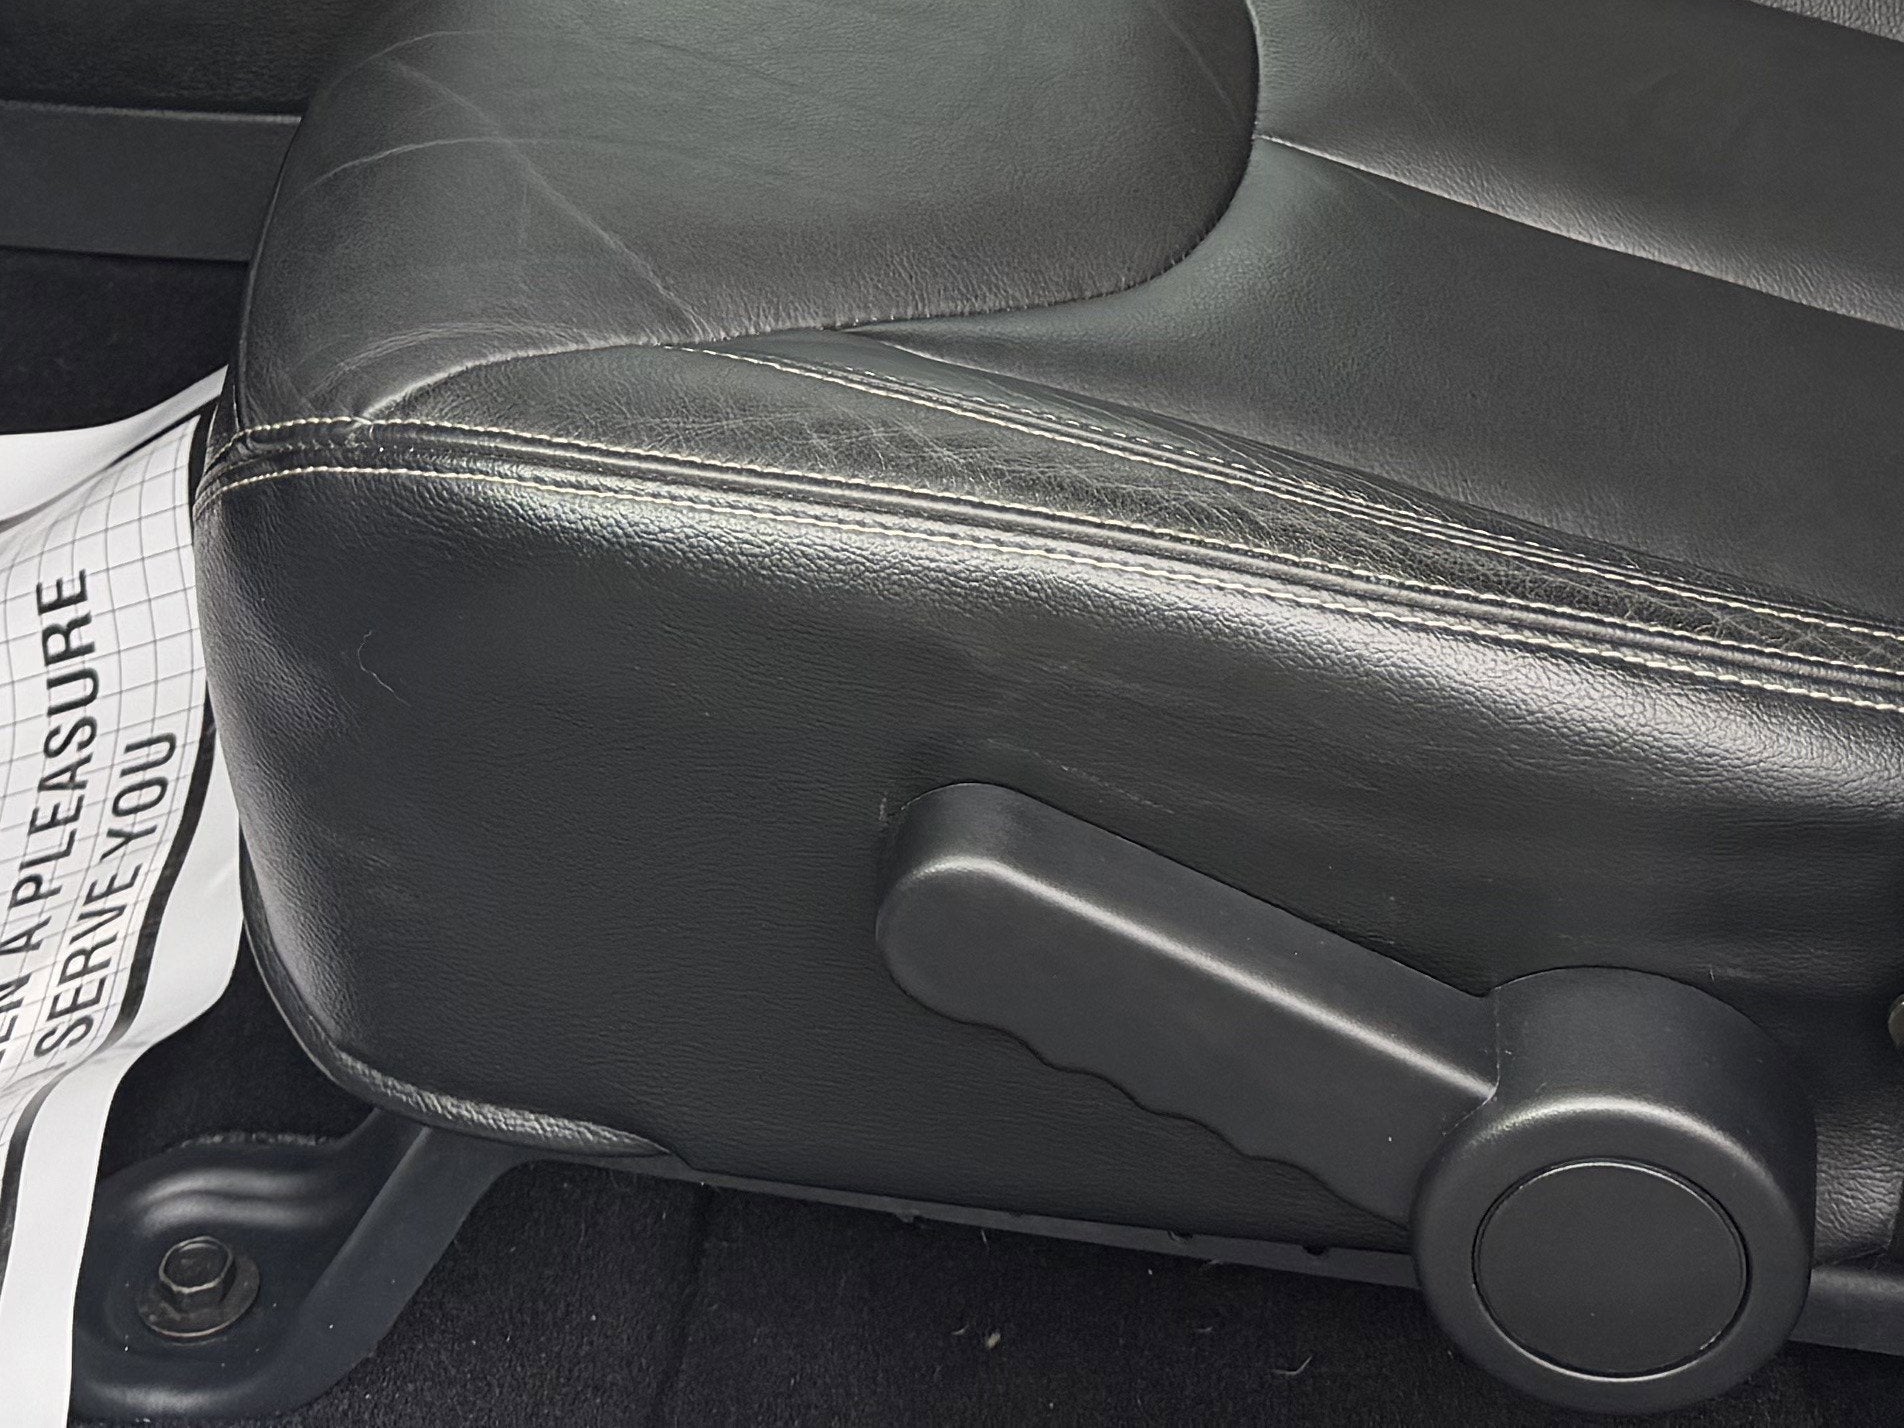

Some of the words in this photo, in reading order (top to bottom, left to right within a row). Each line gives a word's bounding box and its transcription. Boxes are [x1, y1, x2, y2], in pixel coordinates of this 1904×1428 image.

[11, 568, 99, 916] PLEASURE
[34, 863, 140, 1062] SERVE
[112, 731, 180, 858] YOU
